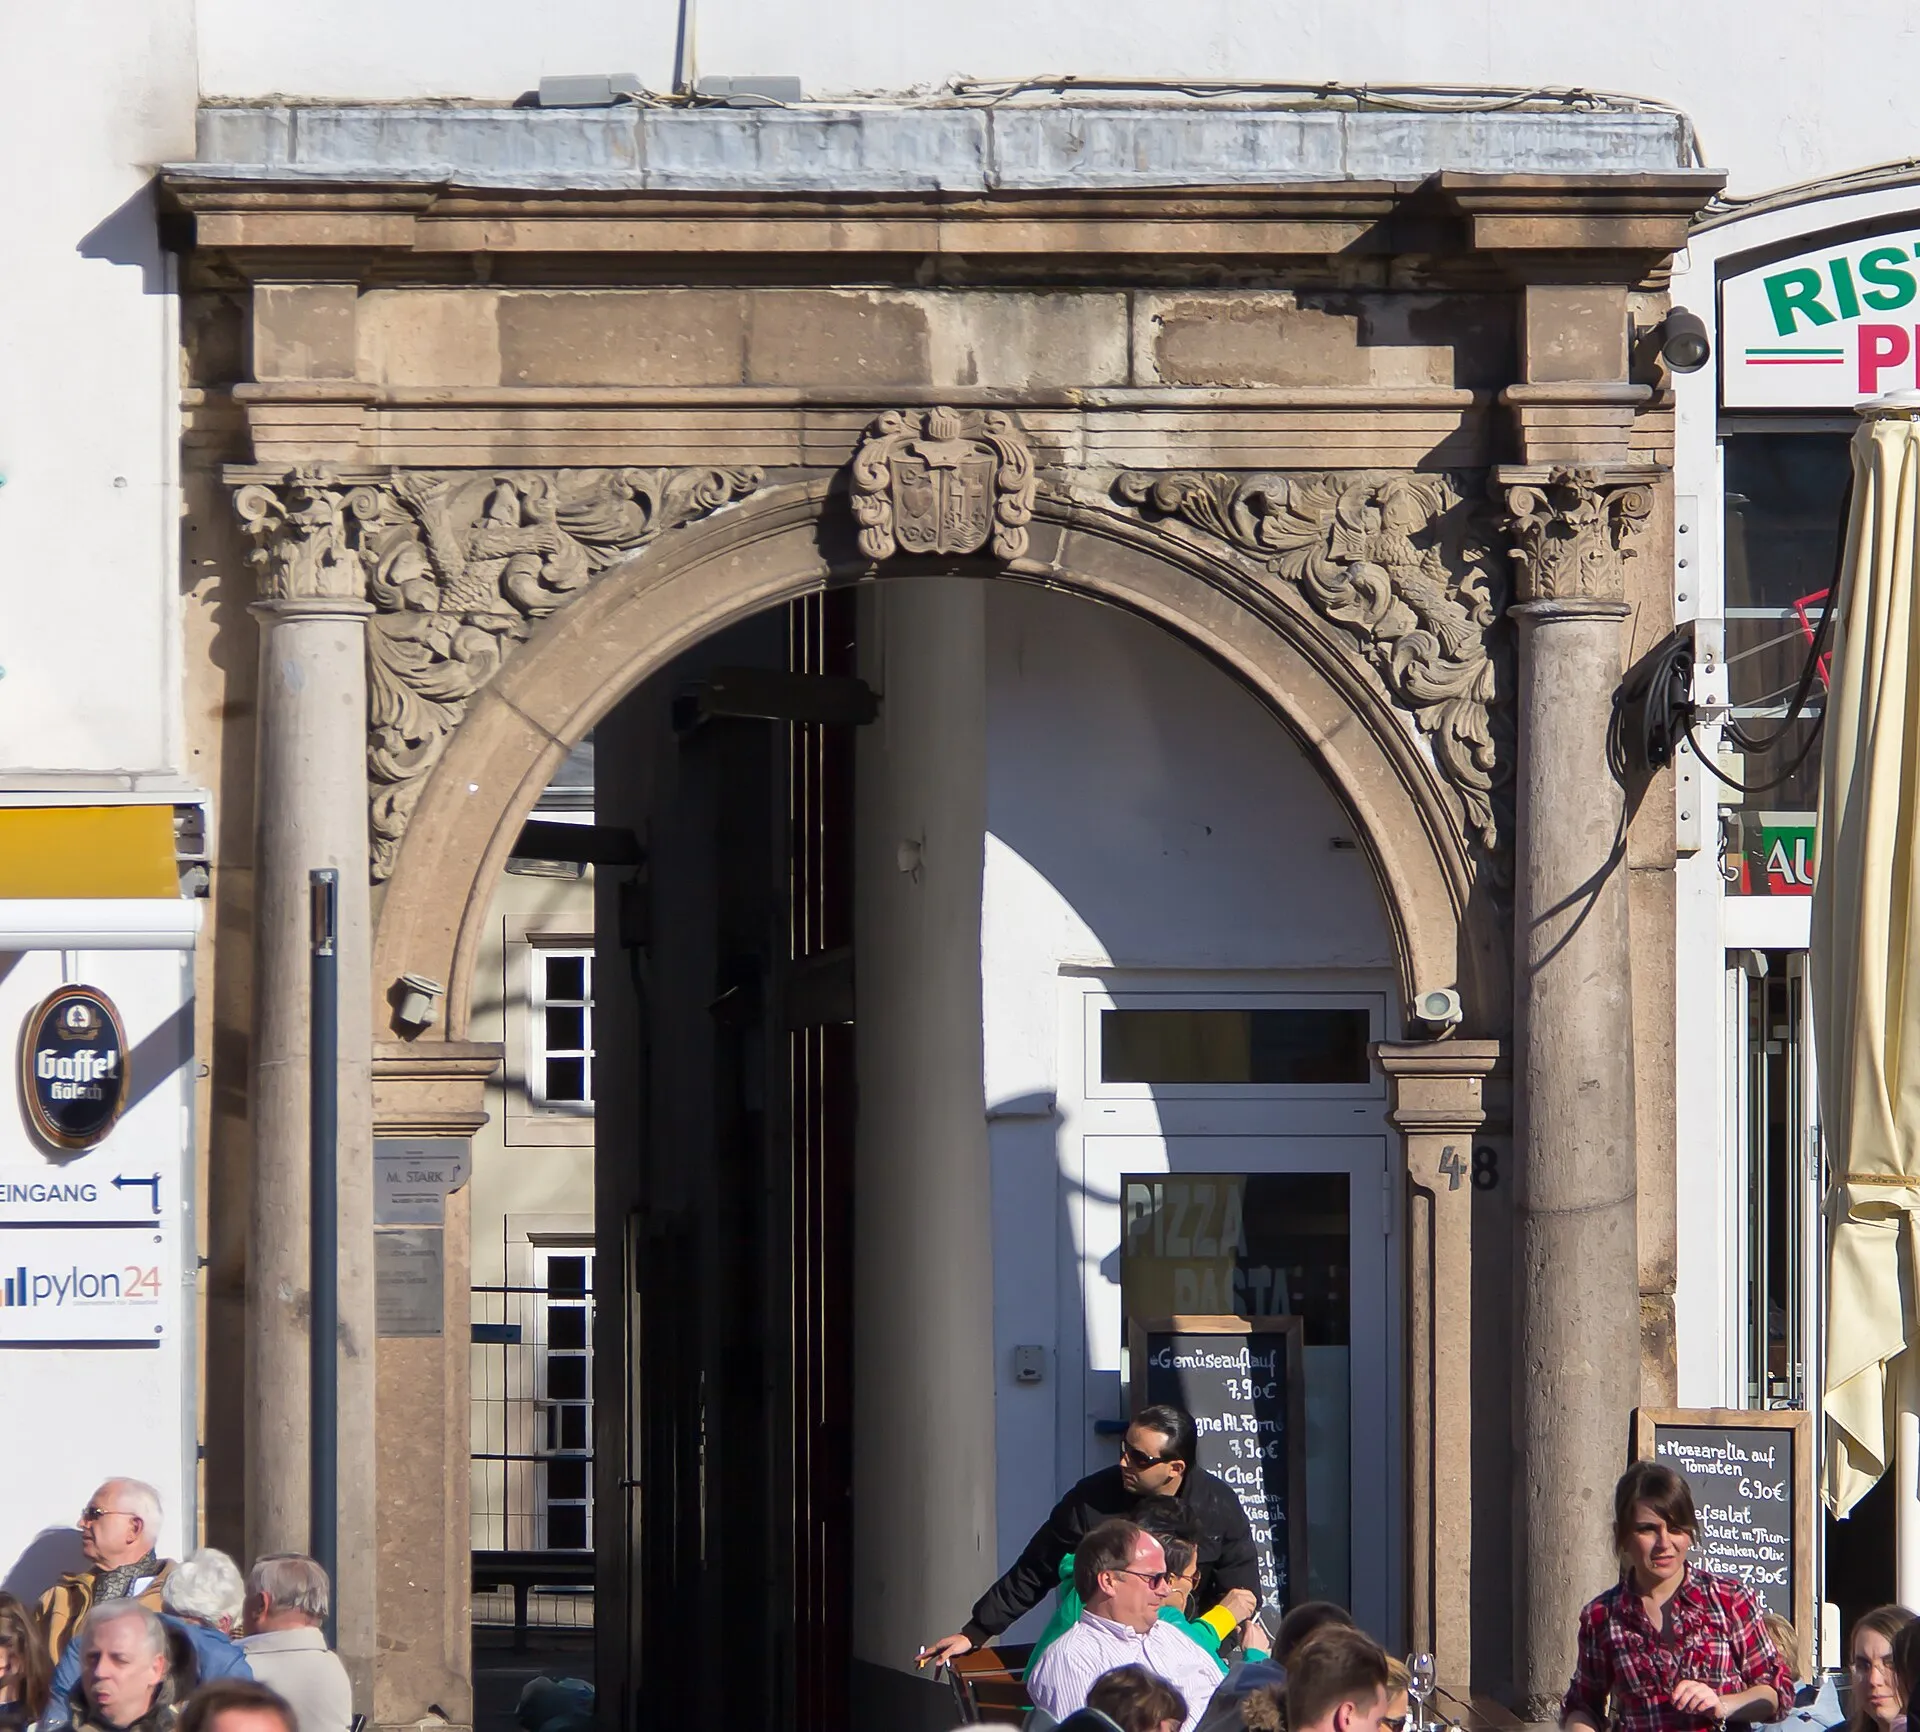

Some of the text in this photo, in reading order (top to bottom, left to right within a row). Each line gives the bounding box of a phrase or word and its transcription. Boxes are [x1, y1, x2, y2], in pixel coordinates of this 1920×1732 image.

[1764, 241, 1920, 336] RIS
[1858, 324, 1920, 393] P
[38, 1048, 117, 1082] Gaffel
[51, 1082, 102, 1100] Kölsch
[406, 1170, 444, 1183] STARK
[1127, 1184, 1248, 1257] PIZZA
[1174, 1266, 1292, 1316] PASTA
[1158, 1346, 1277, 1378] Gemüseauflauf
[1225, 1378, 1277, 1401] 7,90€
[1228, 1438, 1279, 1459] 7,90€
[1751, 1446, 1776, 1469] auf
[1224, 1464, 1264, 1490] Chef
[1680, 1458, 1743, 1477] Tomaten
[1738, 1477, 1787, 1502] 6,90€
[1704, 1524, 1740, 1541] Salat
[1704, 1557, 1738, 1574] Käse
[1738, 1564, 1788, 1585] 7,90€
